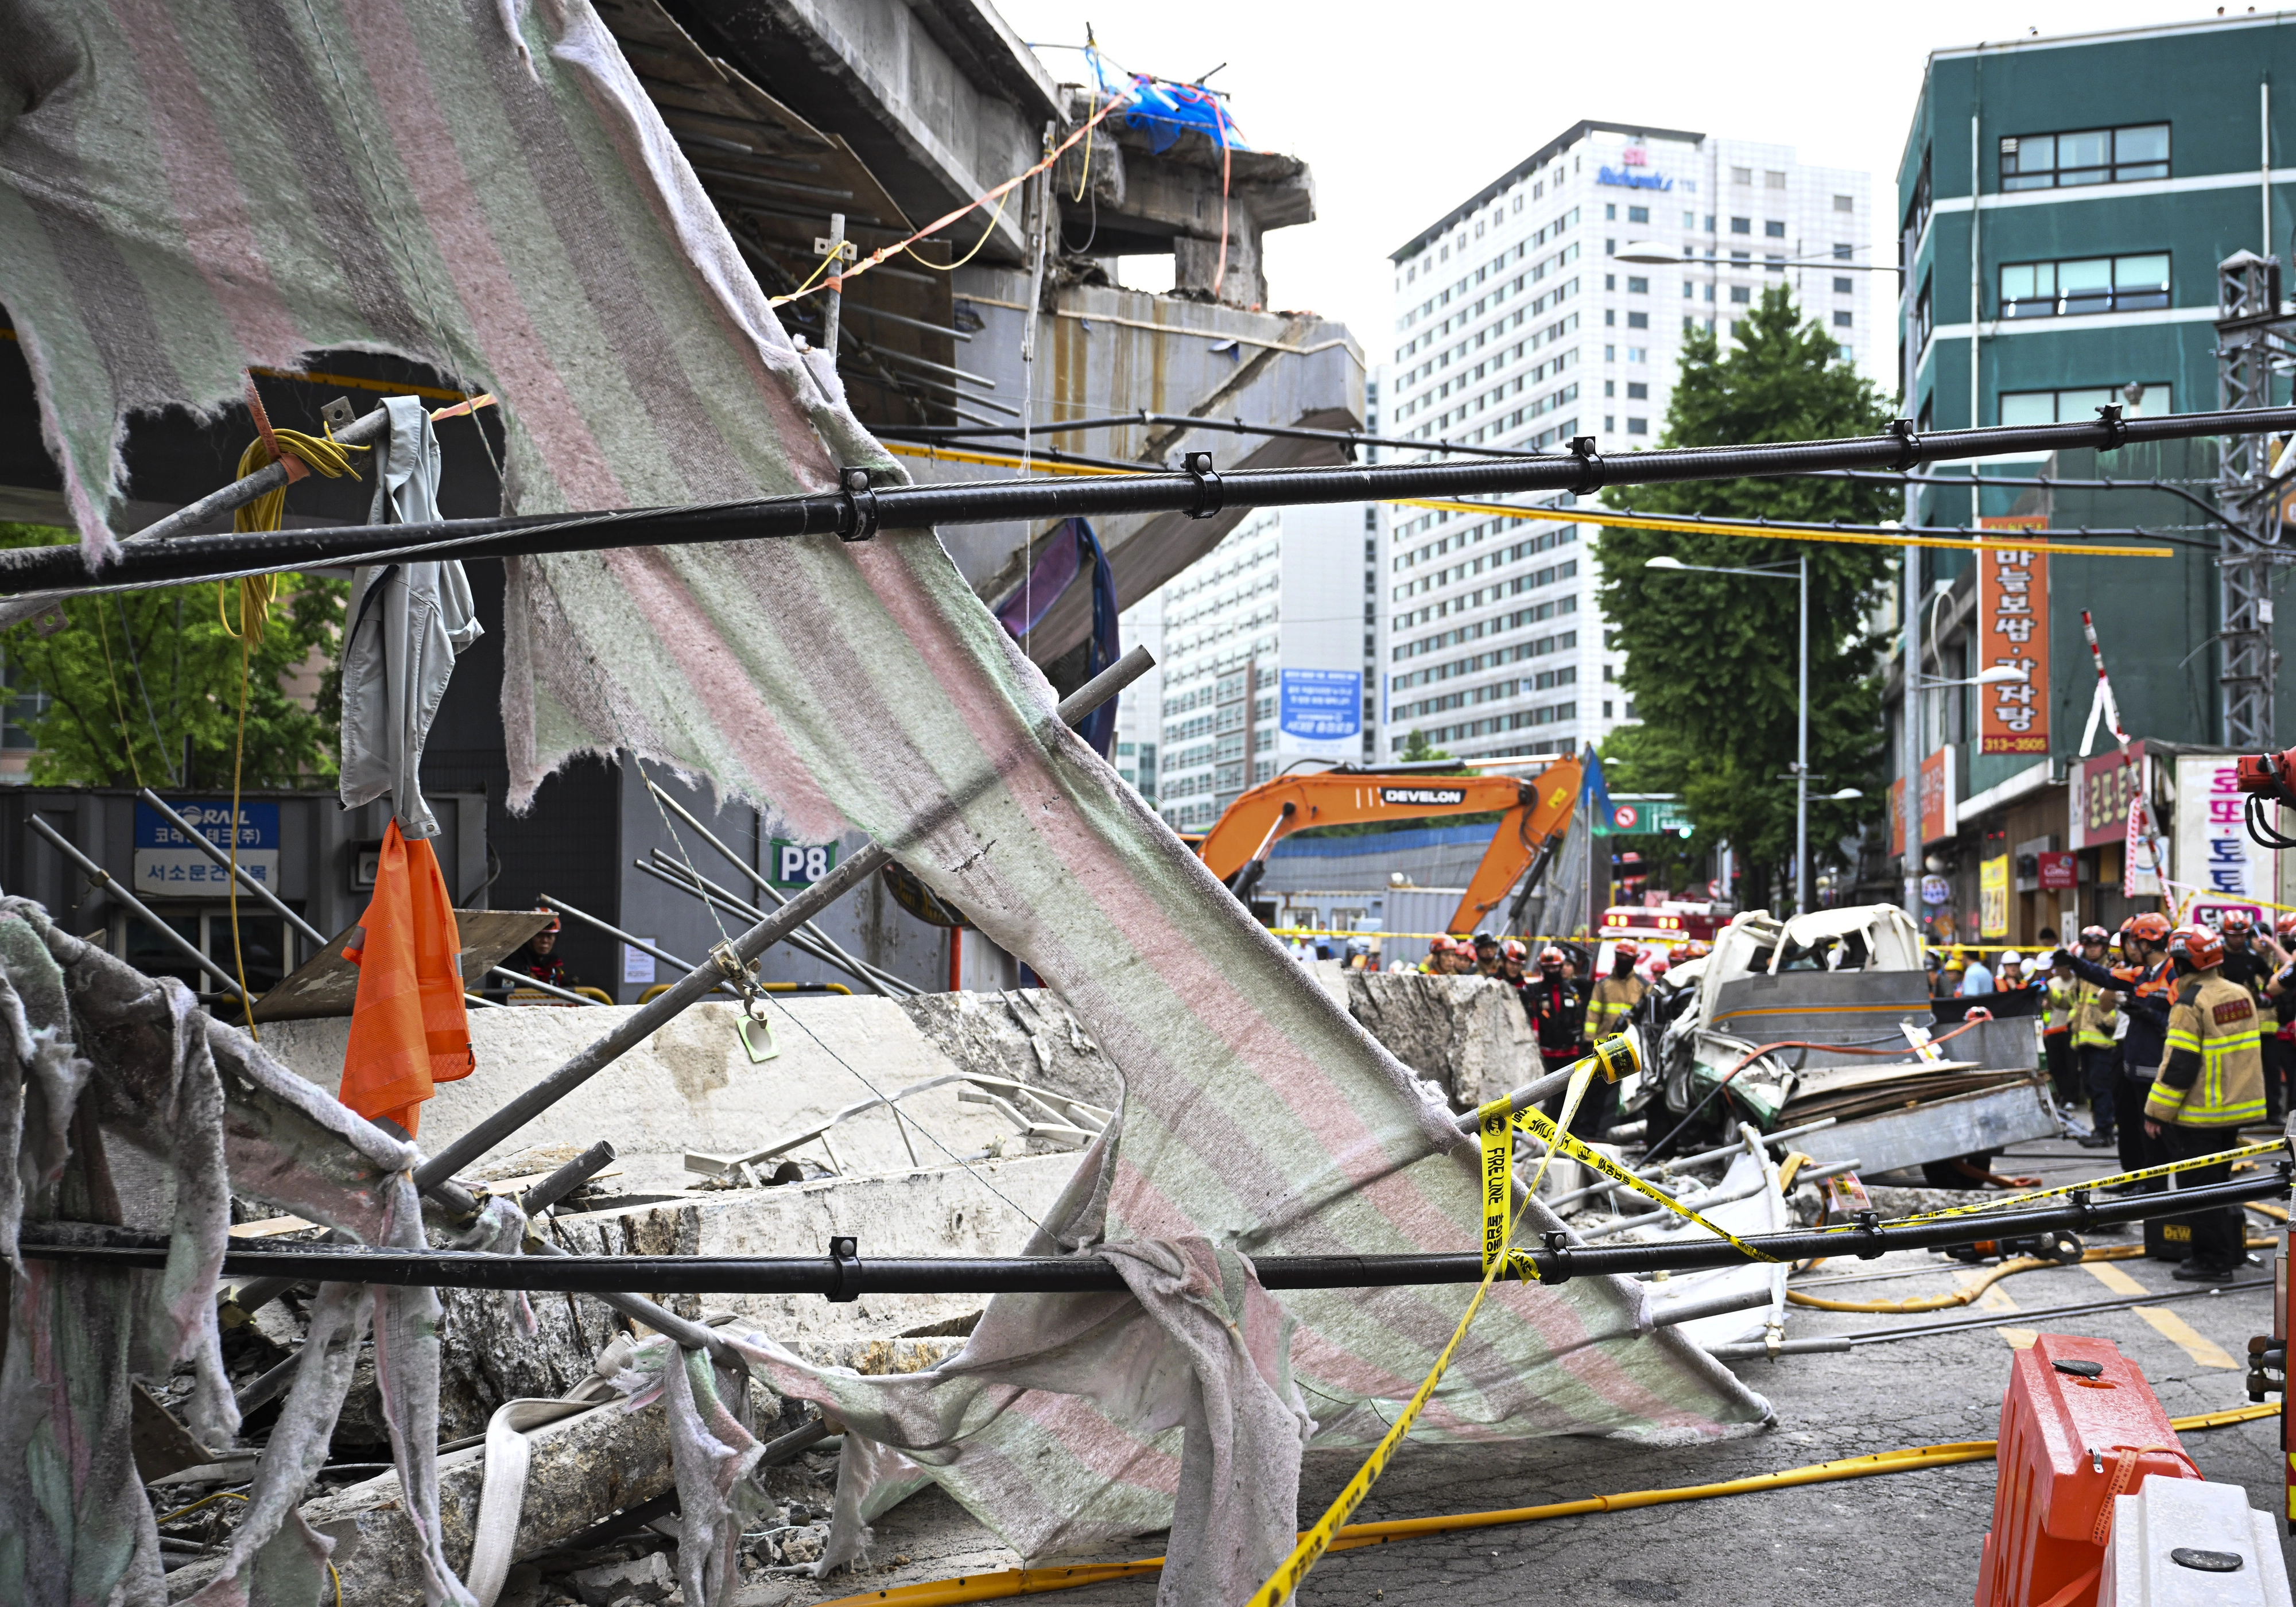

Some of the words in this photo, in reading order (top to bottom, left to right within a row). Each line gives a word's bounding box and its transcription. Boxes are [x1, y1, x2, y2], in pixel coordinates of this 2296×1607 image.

[1386, 790, 1461, 803] DEVELON
[166, 806, 250, 826] ORAL
[148, 864, 267, 882] 서소문건목
[782, 847, 827, 882] P8
[1487, 1147, 1504, 1176] FIRE
[1488, 1175, 1504, 1206] LINE
